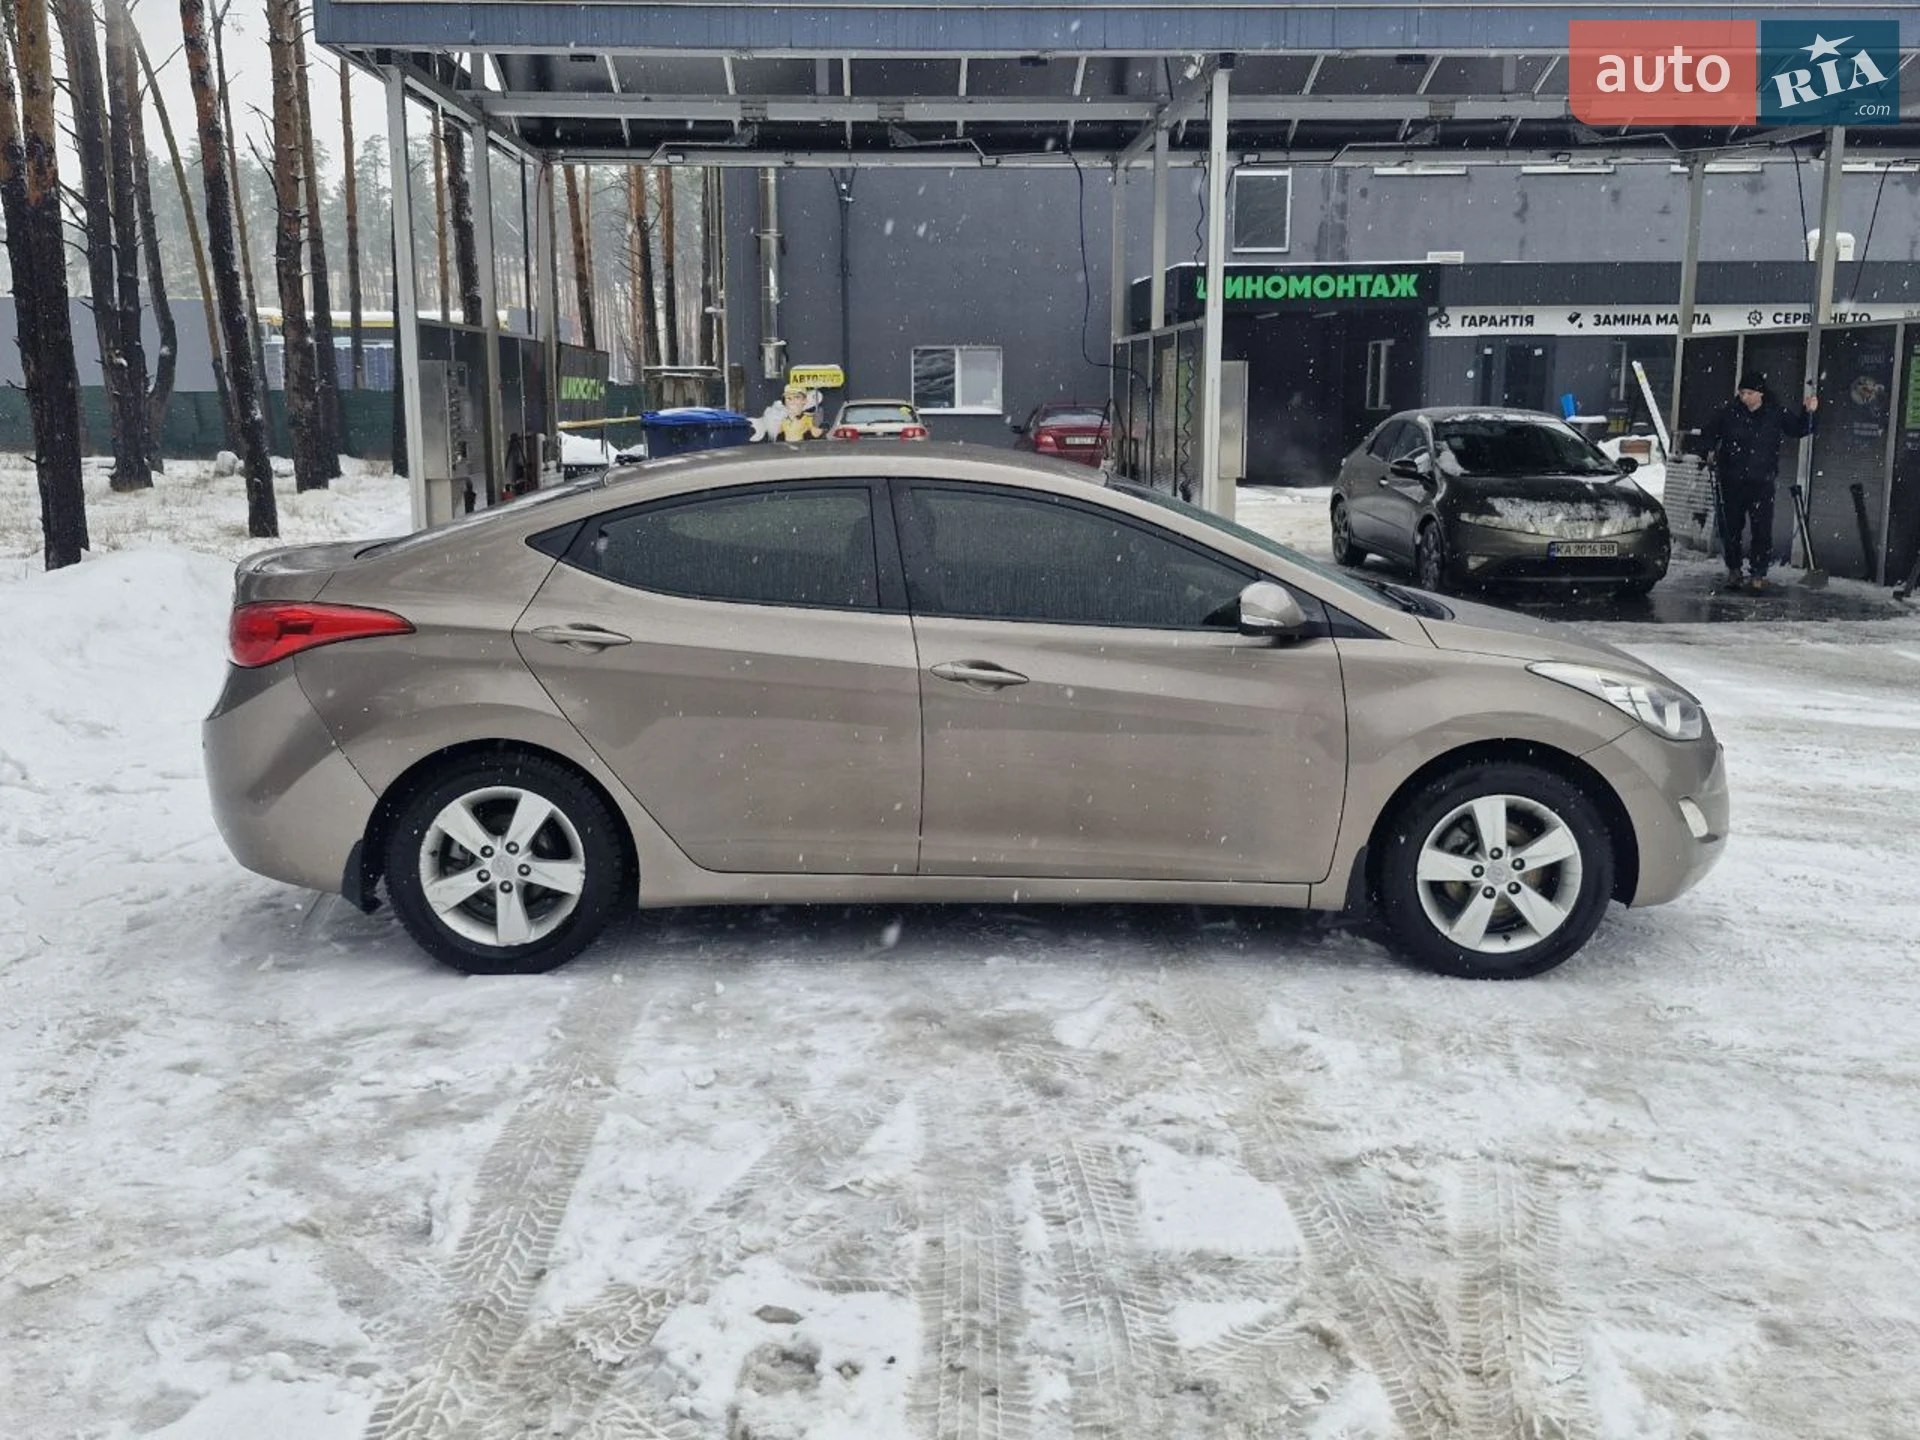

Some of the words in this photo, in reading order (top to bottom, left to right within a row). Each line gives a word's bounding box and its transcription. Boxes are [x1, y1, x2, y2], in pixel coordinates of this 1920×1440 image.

[1460, 313, 1535, 328] ГАРАНТІЯ
[1592, 313, 1652, 327] ЗАМІНА
[1655, 312, 1712, 326] МАЛА
